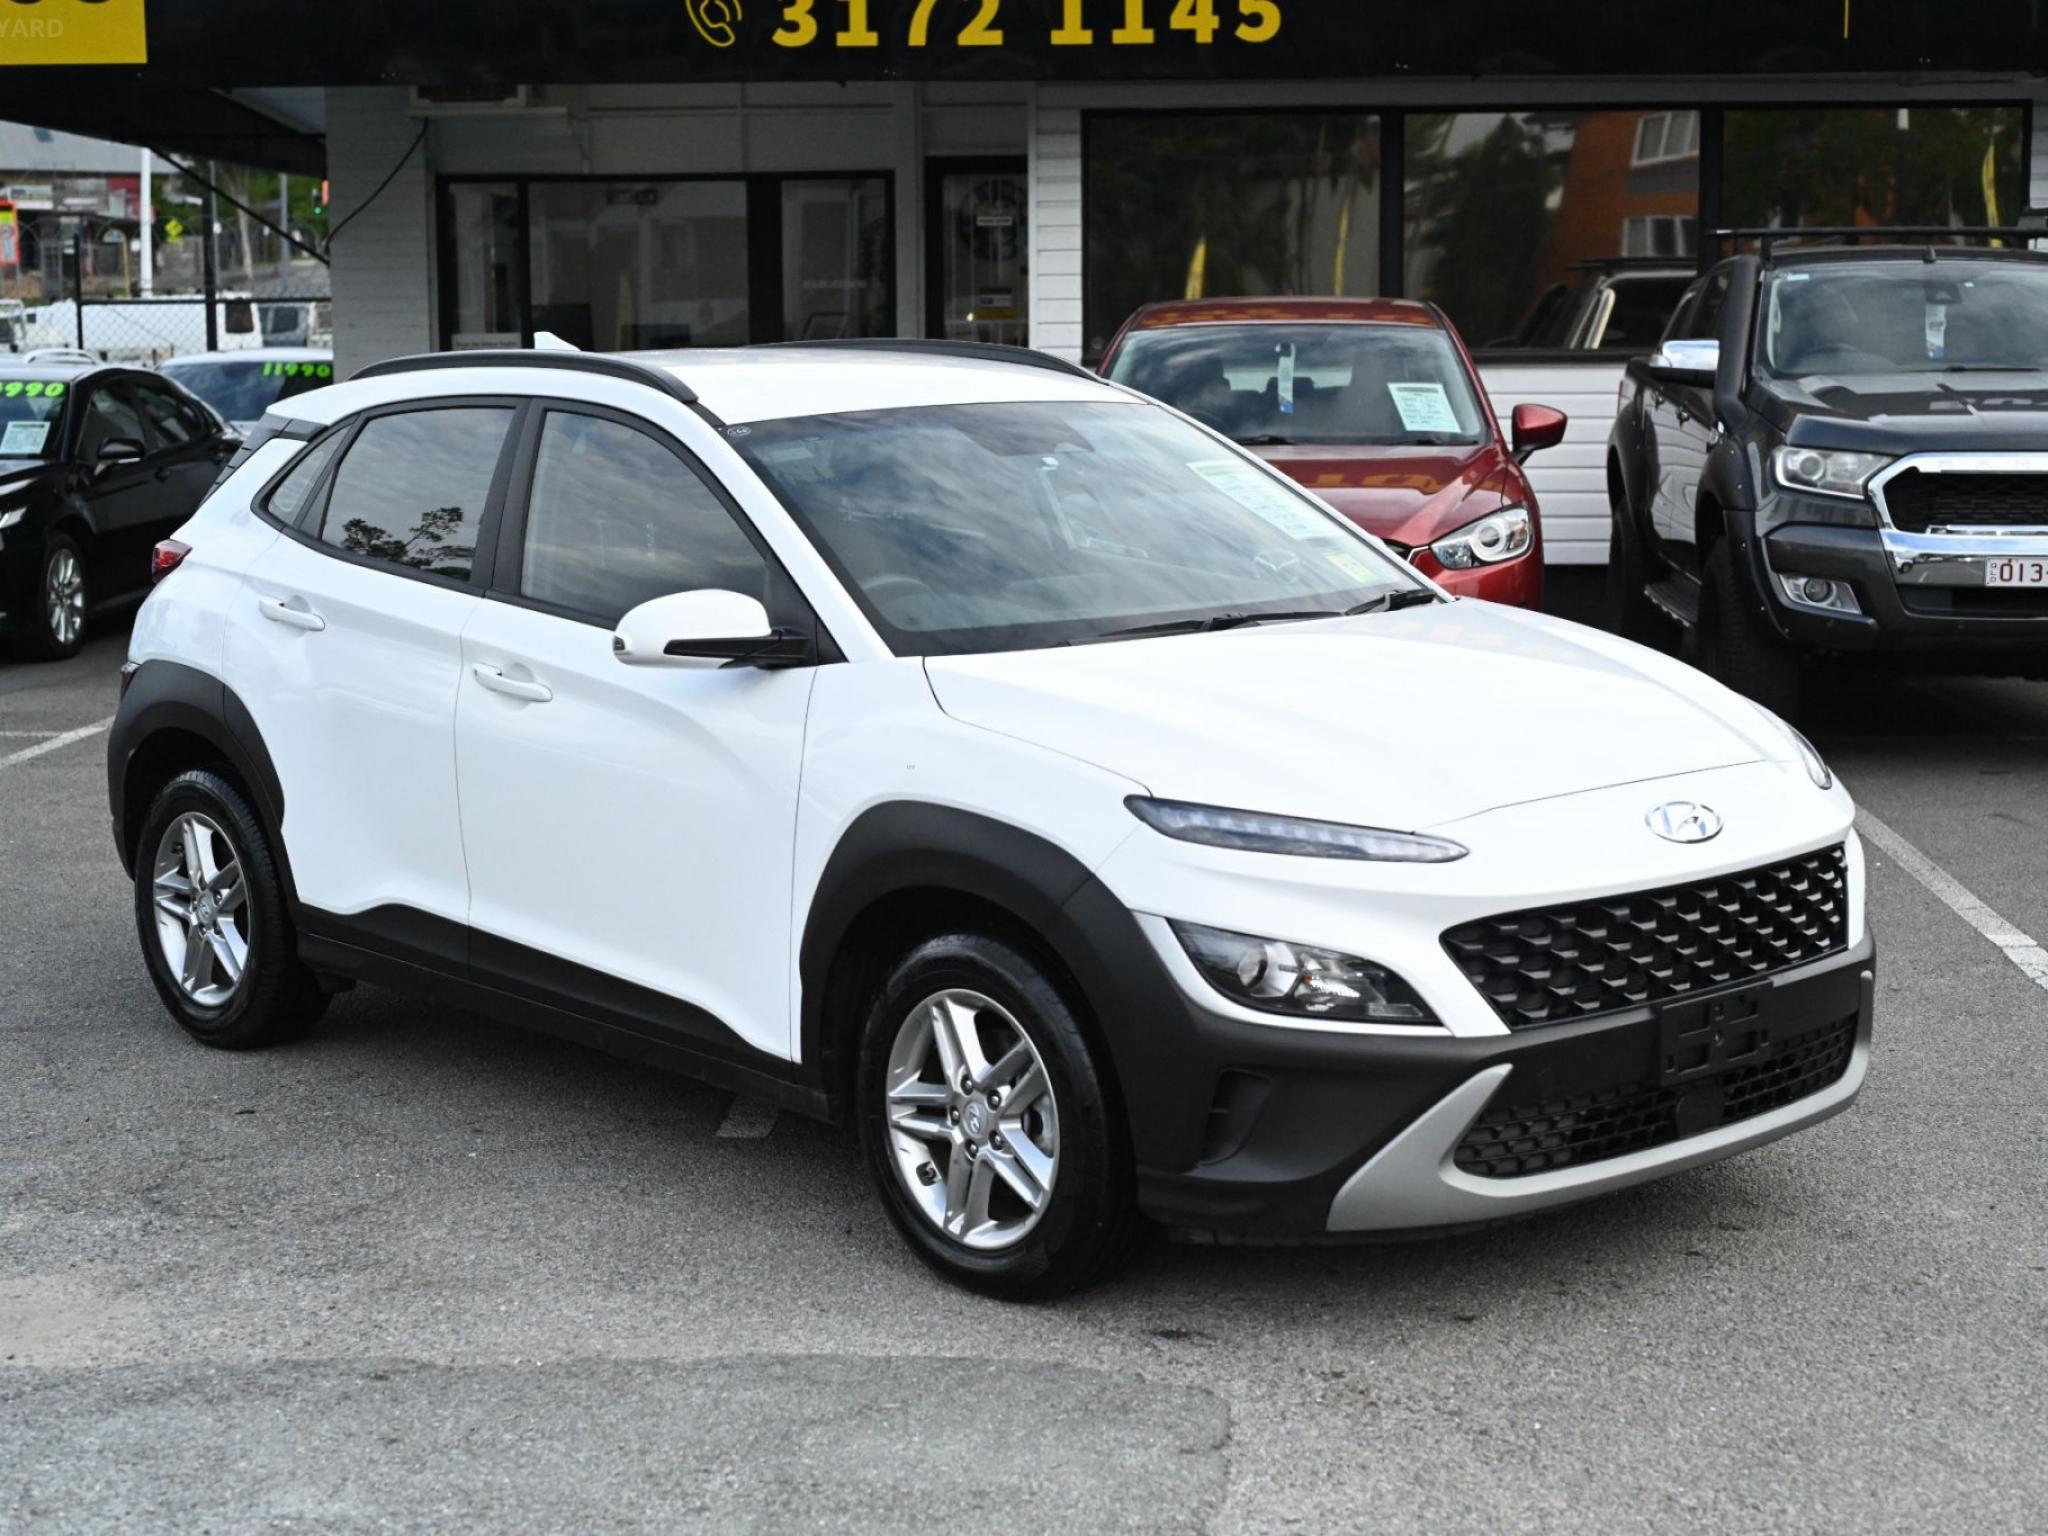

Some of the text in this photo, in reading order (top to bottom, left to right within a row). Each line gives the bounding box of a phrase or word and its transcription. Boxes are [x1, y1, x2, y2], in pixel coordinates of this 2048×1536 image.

[772, 0, 1280, 47] 3172 1145
[263, 362, 332, 377] 11990
[0, 381, 65, 397] 990
